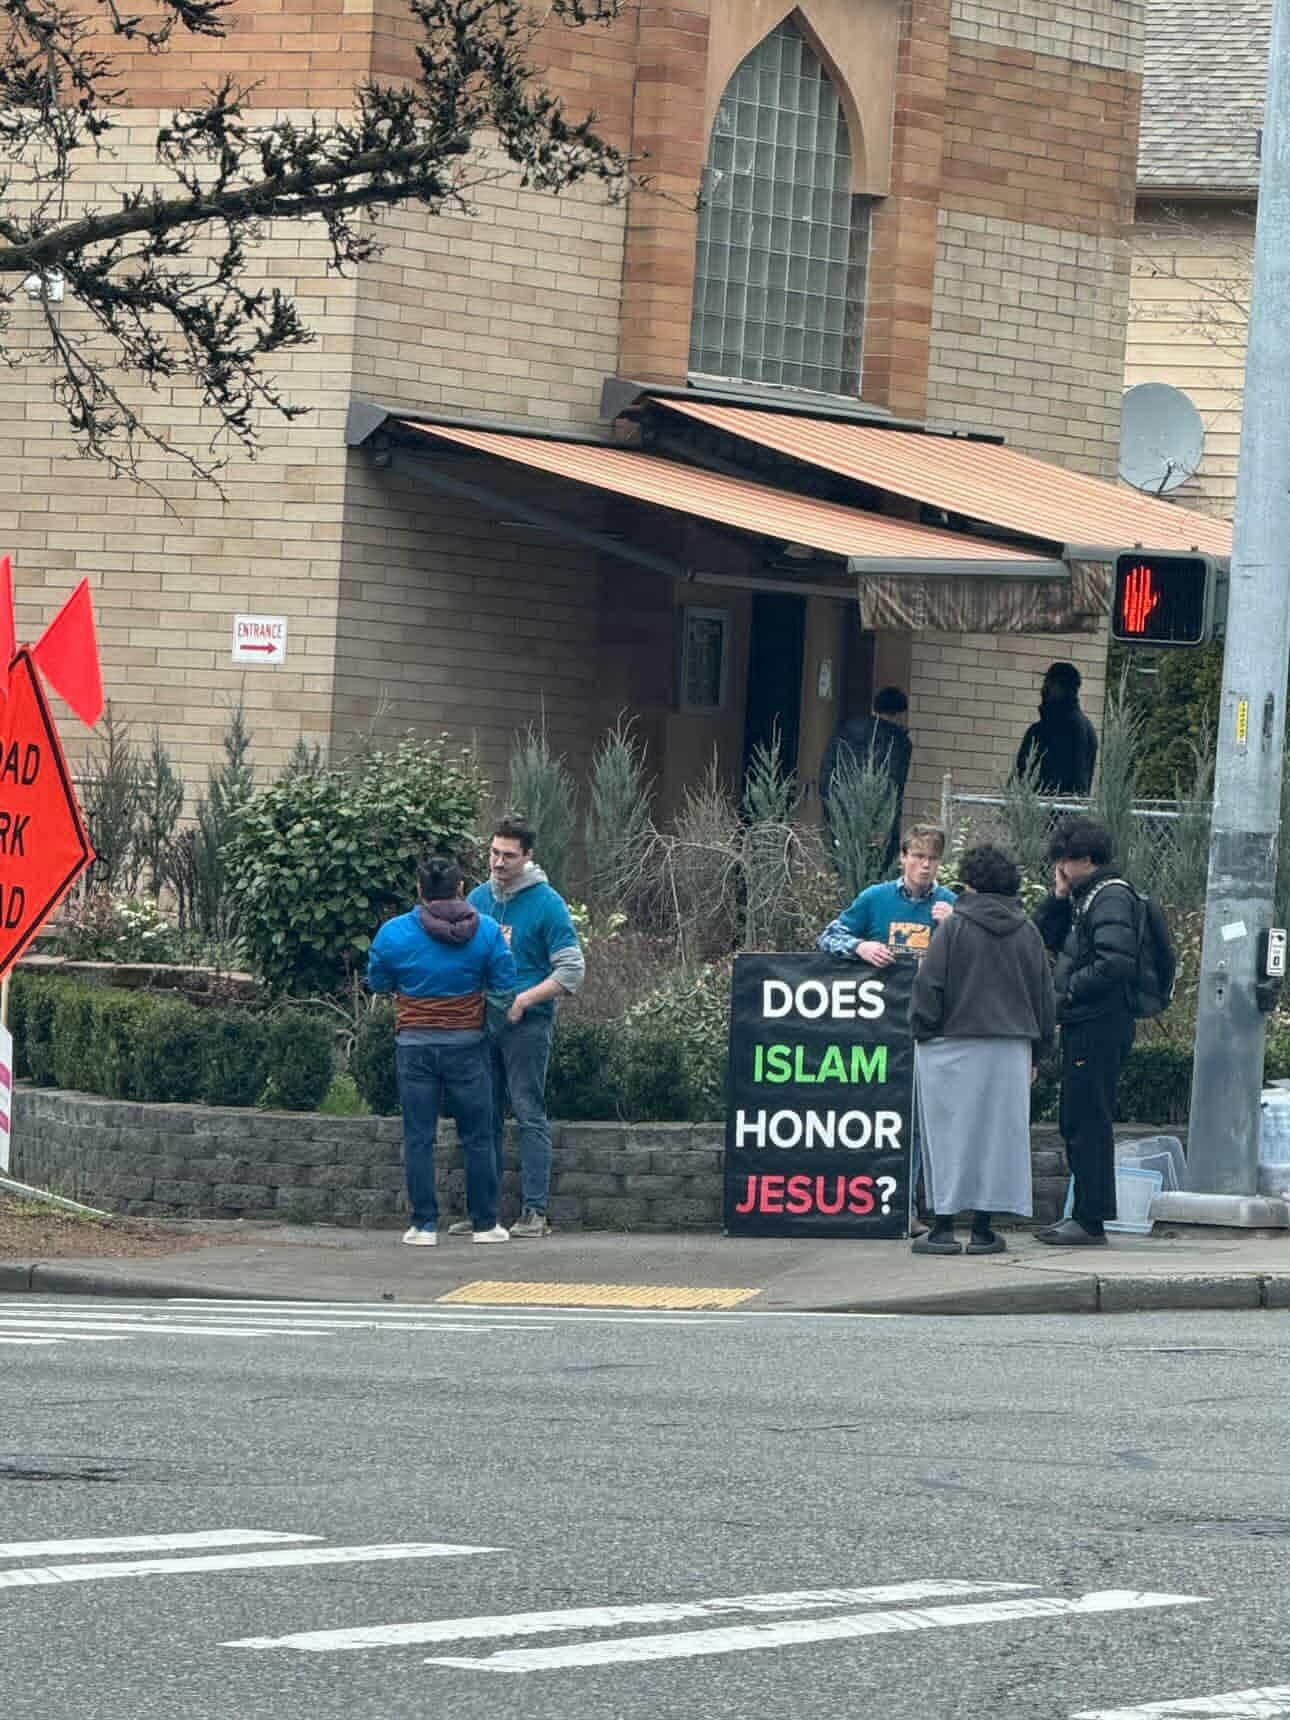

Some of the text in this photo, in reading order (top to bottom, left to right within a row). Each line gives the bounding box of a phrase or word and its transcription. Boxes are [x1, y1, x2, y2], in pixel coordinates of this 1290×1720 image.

[237, 622, 284, 639] ENTRANCE
[0, 741, 40, 785] AD
[762, 979, 886, 1019] DOES
[753, 1044, 888, 1083] ISLAM
[735, 1109, 902, 1149] HONOR
[735, 1175, 897, 1215] JESUS?
